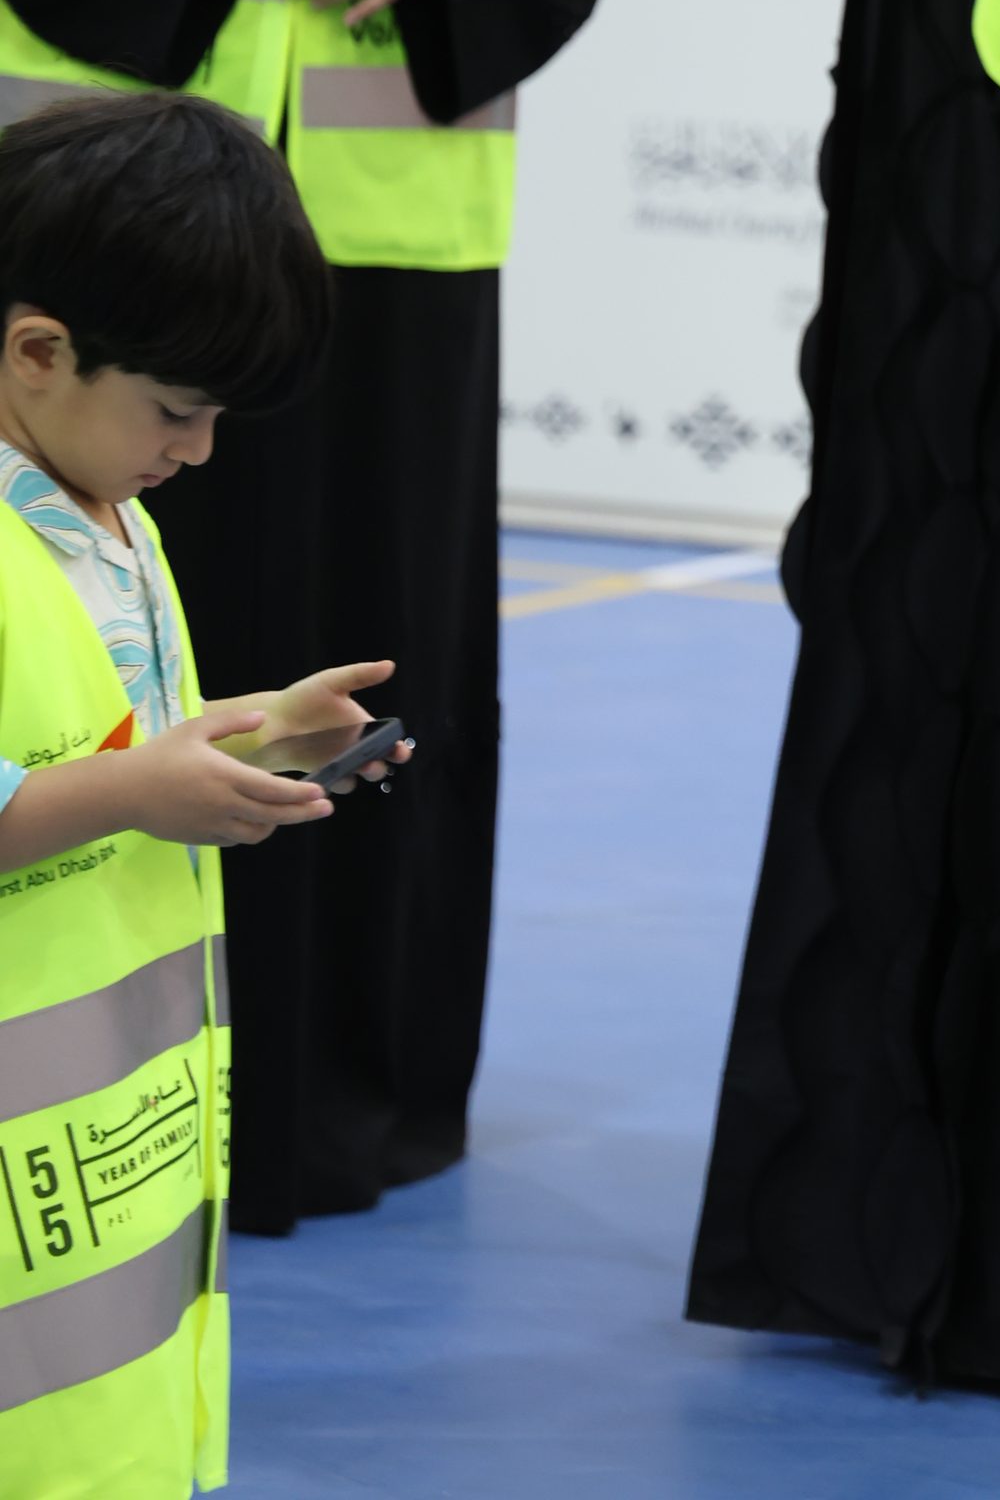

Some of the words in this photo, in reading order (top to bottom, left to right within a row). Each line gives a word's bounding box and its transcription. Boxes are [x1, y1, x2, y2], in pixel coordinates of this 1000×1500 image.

[26, 870, 55, 890] Abu
[26, 1145, 59, 1199] 5
[98, 1157, 138, 1186] YEAR
[140, 1145, 152, 1165] OF
[153, 1119, 194, 1156] FAMILY
[40, 1203, 73, 1257] 5
